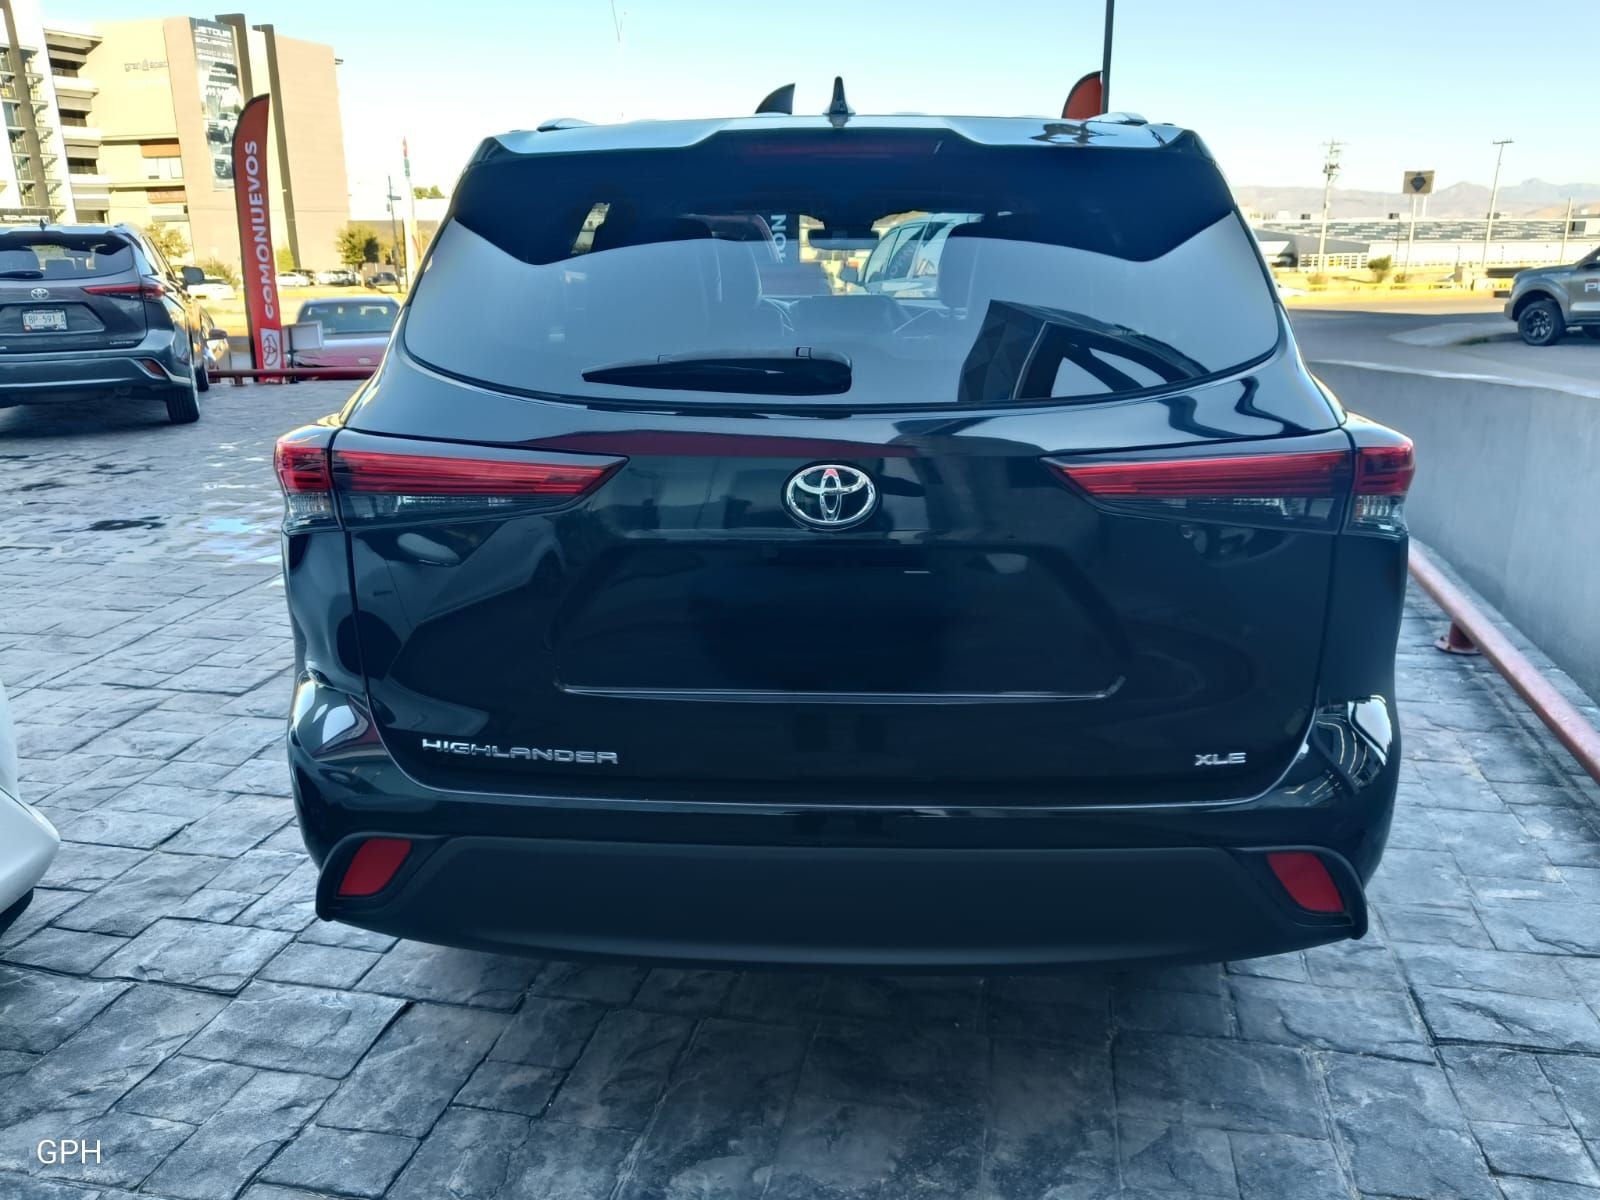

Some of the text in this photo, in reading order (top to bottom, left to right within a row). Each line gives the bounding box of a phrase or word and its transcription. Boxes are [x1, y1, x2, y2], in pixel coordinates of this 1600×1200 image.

[245, 140, 273, 320] COMONUEVOS
[422, 738, 619, 765] HIGHLANDER
[1194, 752, 1247, 766] XLE
